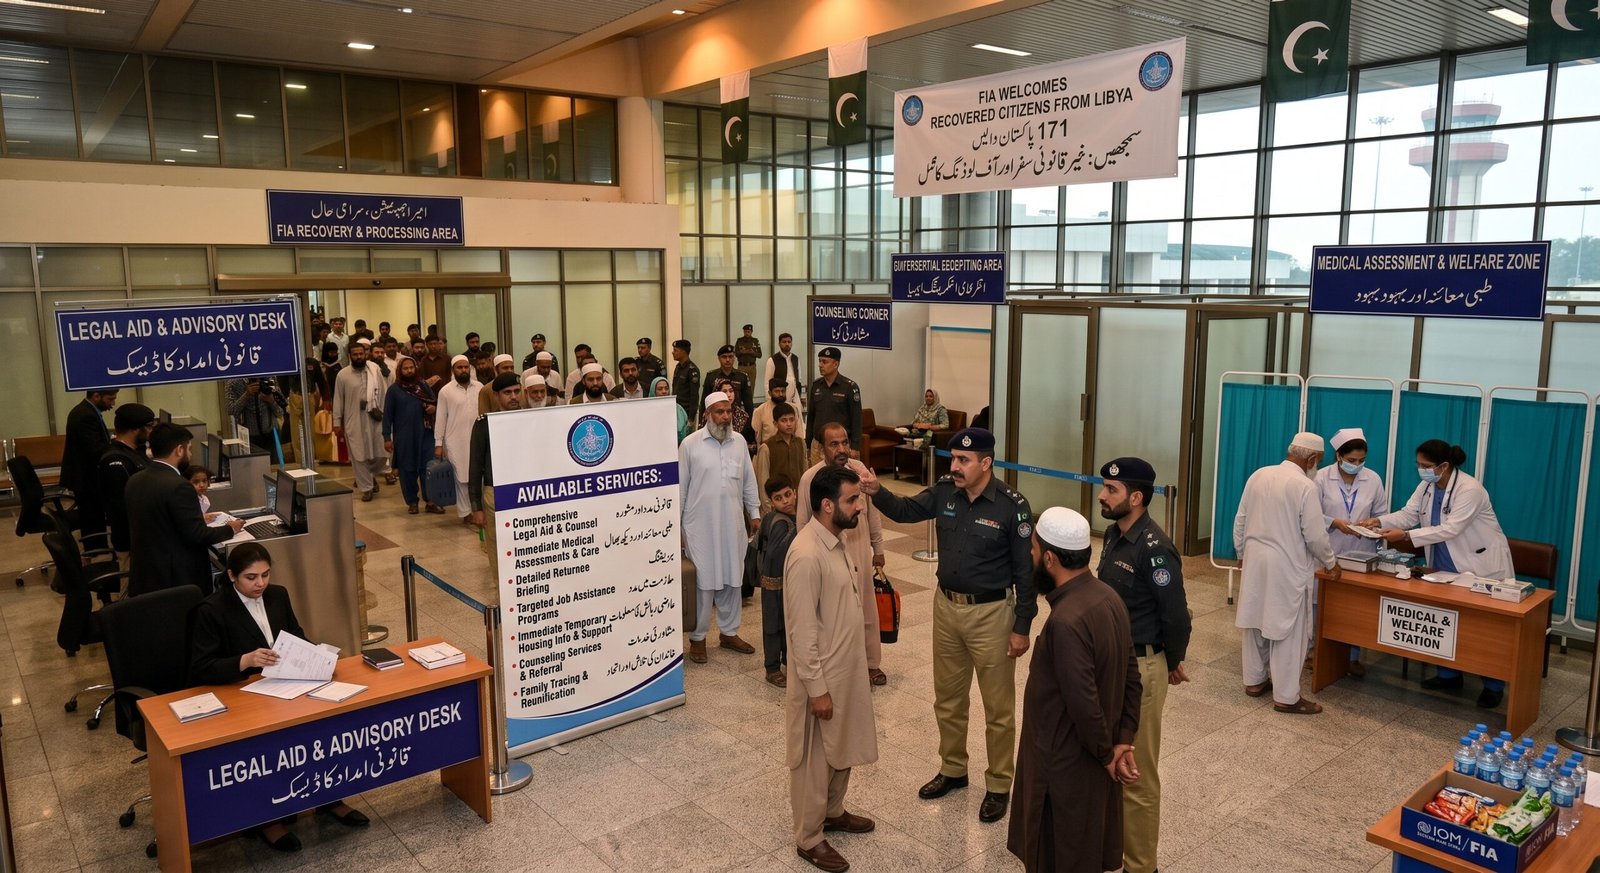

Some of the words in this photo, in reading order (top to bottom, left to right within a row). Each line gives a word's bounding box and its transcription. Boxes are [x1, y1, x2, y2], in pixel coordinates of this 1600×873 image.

[978, 88, 996, 105] FIA
[998, 77, 1068, 101] WELCOMES
[930, 108, 995, 129] RECOVERED
[998, 99, 1051, 120] CITIZENS
[1053, 93, 1090, 113] FROM
[1094, 87, 1133, 107] LIBYA
[999, 121, 1034, 149] پاکستان
[1037, 118, 1068, 140] 171
[996, 158, 1014, 176] اور
[1011, 156, 1032, 181] سفر
[1064, 145, 1085, 175] غیر
[277, 224, 295, 237] FIA
[297, 225, 353, 239] RECOVERY
[356, 226, 363, 239] &
[366, 226, 430, 239] PROCESSING
[431, 227, 459, 240] AREA
[983, 259, 1003, 271] AREA
[1317, 255, 1361, 271] MEDICAL
[1363, 254, 1435, 271] ASSESSMENT
[1437, 254, 1446, 270] &
[1449, 254, 1504, 270] WELFARE
[1506, 253, 1542, 270] ZONE
[1408, 288, 1427, 304] اور
[1465, 277, 1493, 308] طبی
[815, 306, 858, 319] COUNSELING
[859, 307, 889, 321] CORNER
[68, 320, 123, 341] LEGAL
[127, 318, 152, 338] AID
[157, 318, 168, 336] &
[171, 313, 245, 336] ADVISORY
[250, 311, 288, 331] DESK
[107, 346, 160, 377] ڈیسک
[178, 350, 212, 372] امداد
[216, 337, 262, 371] قانونی
[517, 478, 592, 503] AVAILABLE
[596, 468, 662, 492] SERVICES:
[512, 510, 578, 529] Comprehensive
[513, 528, 538, 541] Legal
[540, 524, 554, 537] Aid
[556, 523, 563, 533] &
[565, 518, 598, 532] Counsel
[514, 540, 560, 557] Immediate
[561, 533, 595, 548] Medical
[515, 551, 570, 569] Assessments
[572, 548, 579, 559] &
[581, 546, 600, 558] Care
[515, 570, 551, 585] Detailed
[553, 563, 590, 578] Returnee
[516, 584, 550, 598] Briefing
[516, 597, 554, 614] Targeted
[556, 594, 571, 606] Job
[573, 585, 616, 602] Assistance
[518, 609, 559, 626] Programs
[1387, 604, 1438, 624] MEDICAL
[1441, 616, 1451, 627] &
[518, 624, 563, 642] Immediate
[564, 614, 608, 631] Temporary
[518, 638, 553, 654] Housing
[555, 634, 571, 645] Info
[573, 630, 580, 641] &
[581, 623, 613, 639] Support
[1391, 617, 1445, 639] WELFARE
[1392, 631, 1441, 650] STATION
[519, 651, 566, 670] Counseling
[567, 642, 602, 658] Services
[520, 671, 527, 682] &
[529, 662, 563, 680] Referral
[520, 681, 549, 697] Family
[550, 674, 581, 689] Tracing
[582, 670, 589, 681] &
[521, 687, 576, 709] Reunification
[208, 754, 273, 790] LEGAL
[276, 744, 308, 772] AID
[312, 739, 325, 761] &
[329, 714, 415, 757] ADVISORY
[419, 701, 462, 732] DESK
[334, 759, 368, 786] امداد
[370, 746, 412, 778] قانونی
[271, 771, 322, 805] ڈیسک
[1433, 826, 1462, 845] IOM
[1469, 840, 1499, 862] FIA
